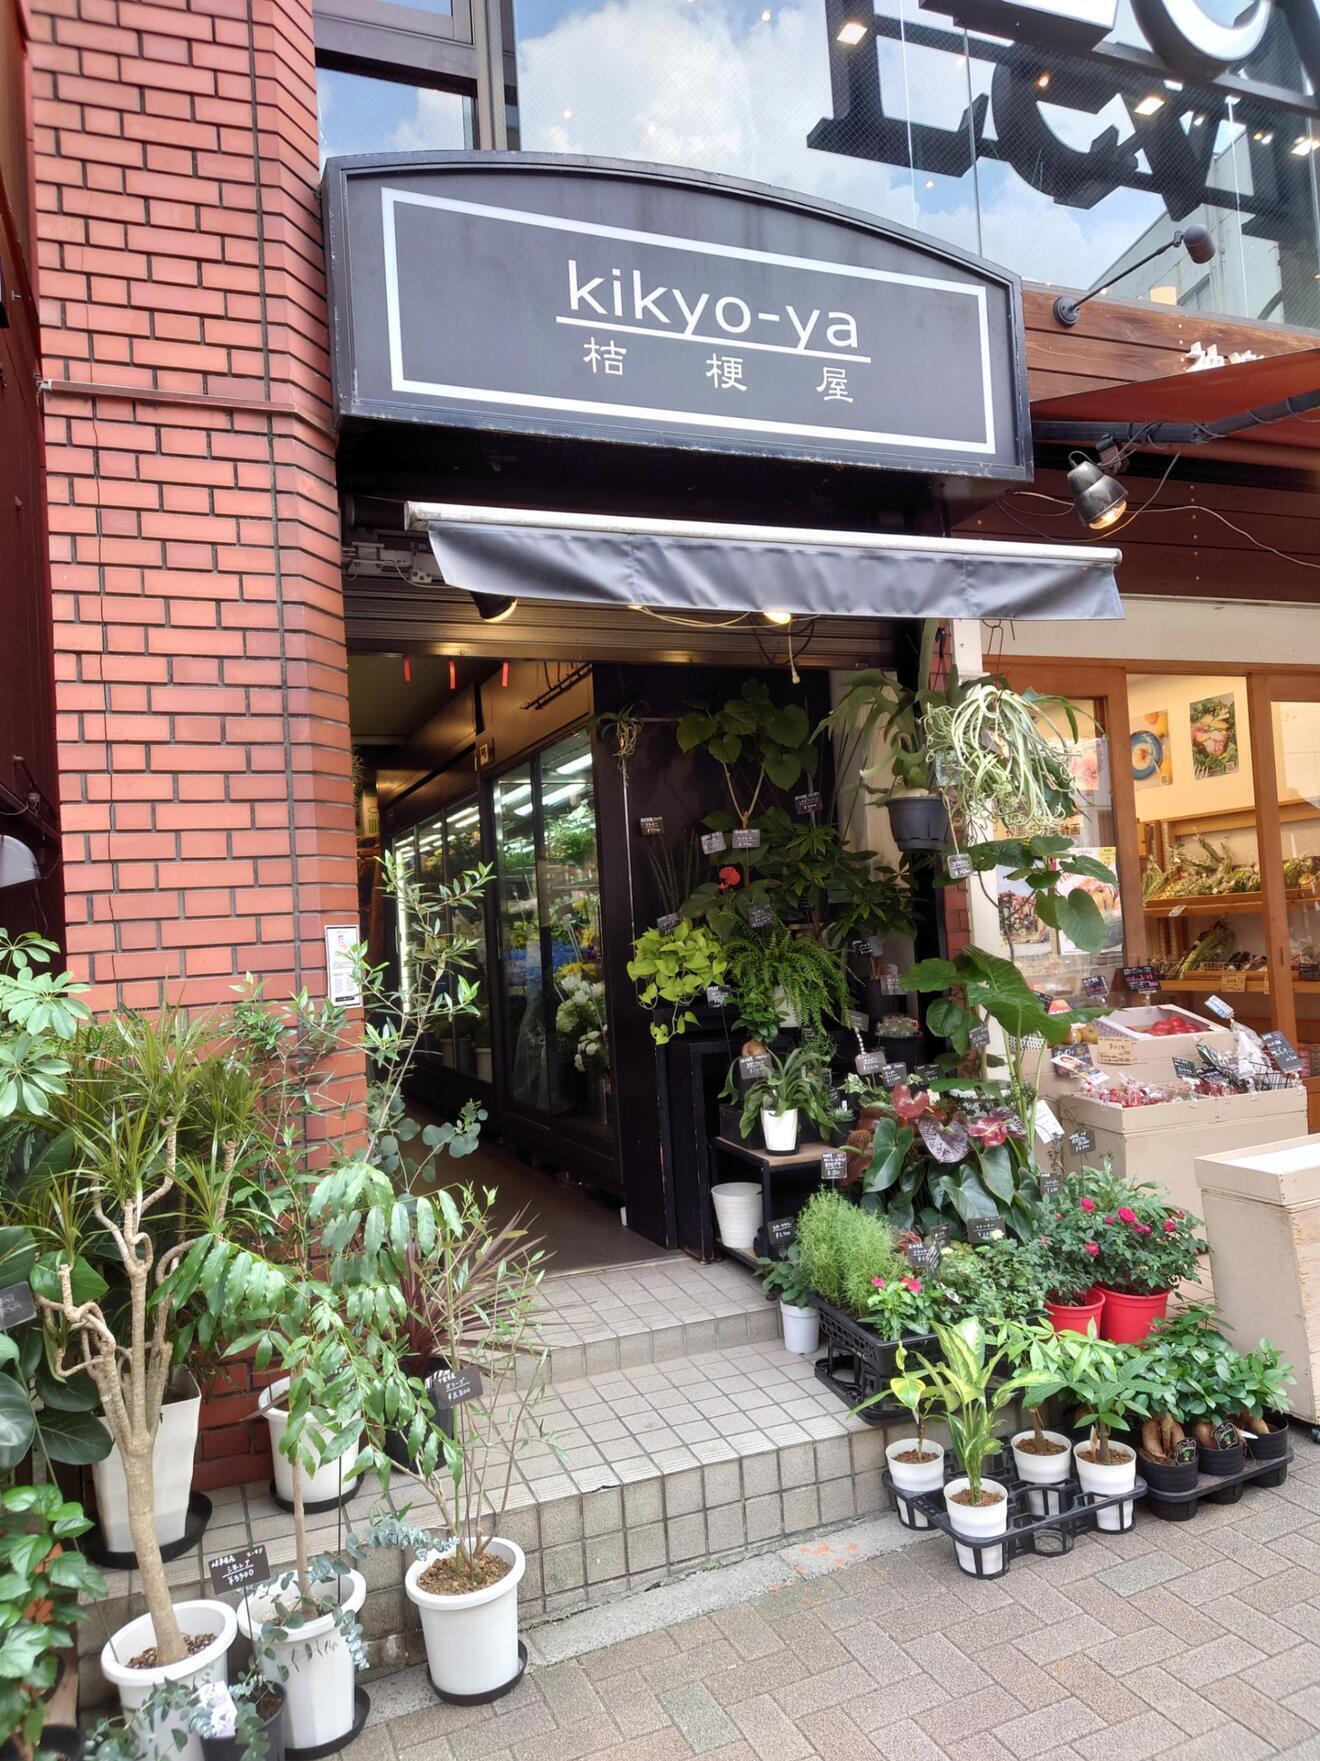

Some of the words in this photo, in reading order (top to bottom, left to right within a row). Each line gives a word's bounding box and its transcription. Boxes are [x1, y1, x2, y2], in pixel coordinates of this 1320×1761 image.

[567, 258, 860, 352] kikyo-ya
[582, 335, 855, 404] 桔梗屋
